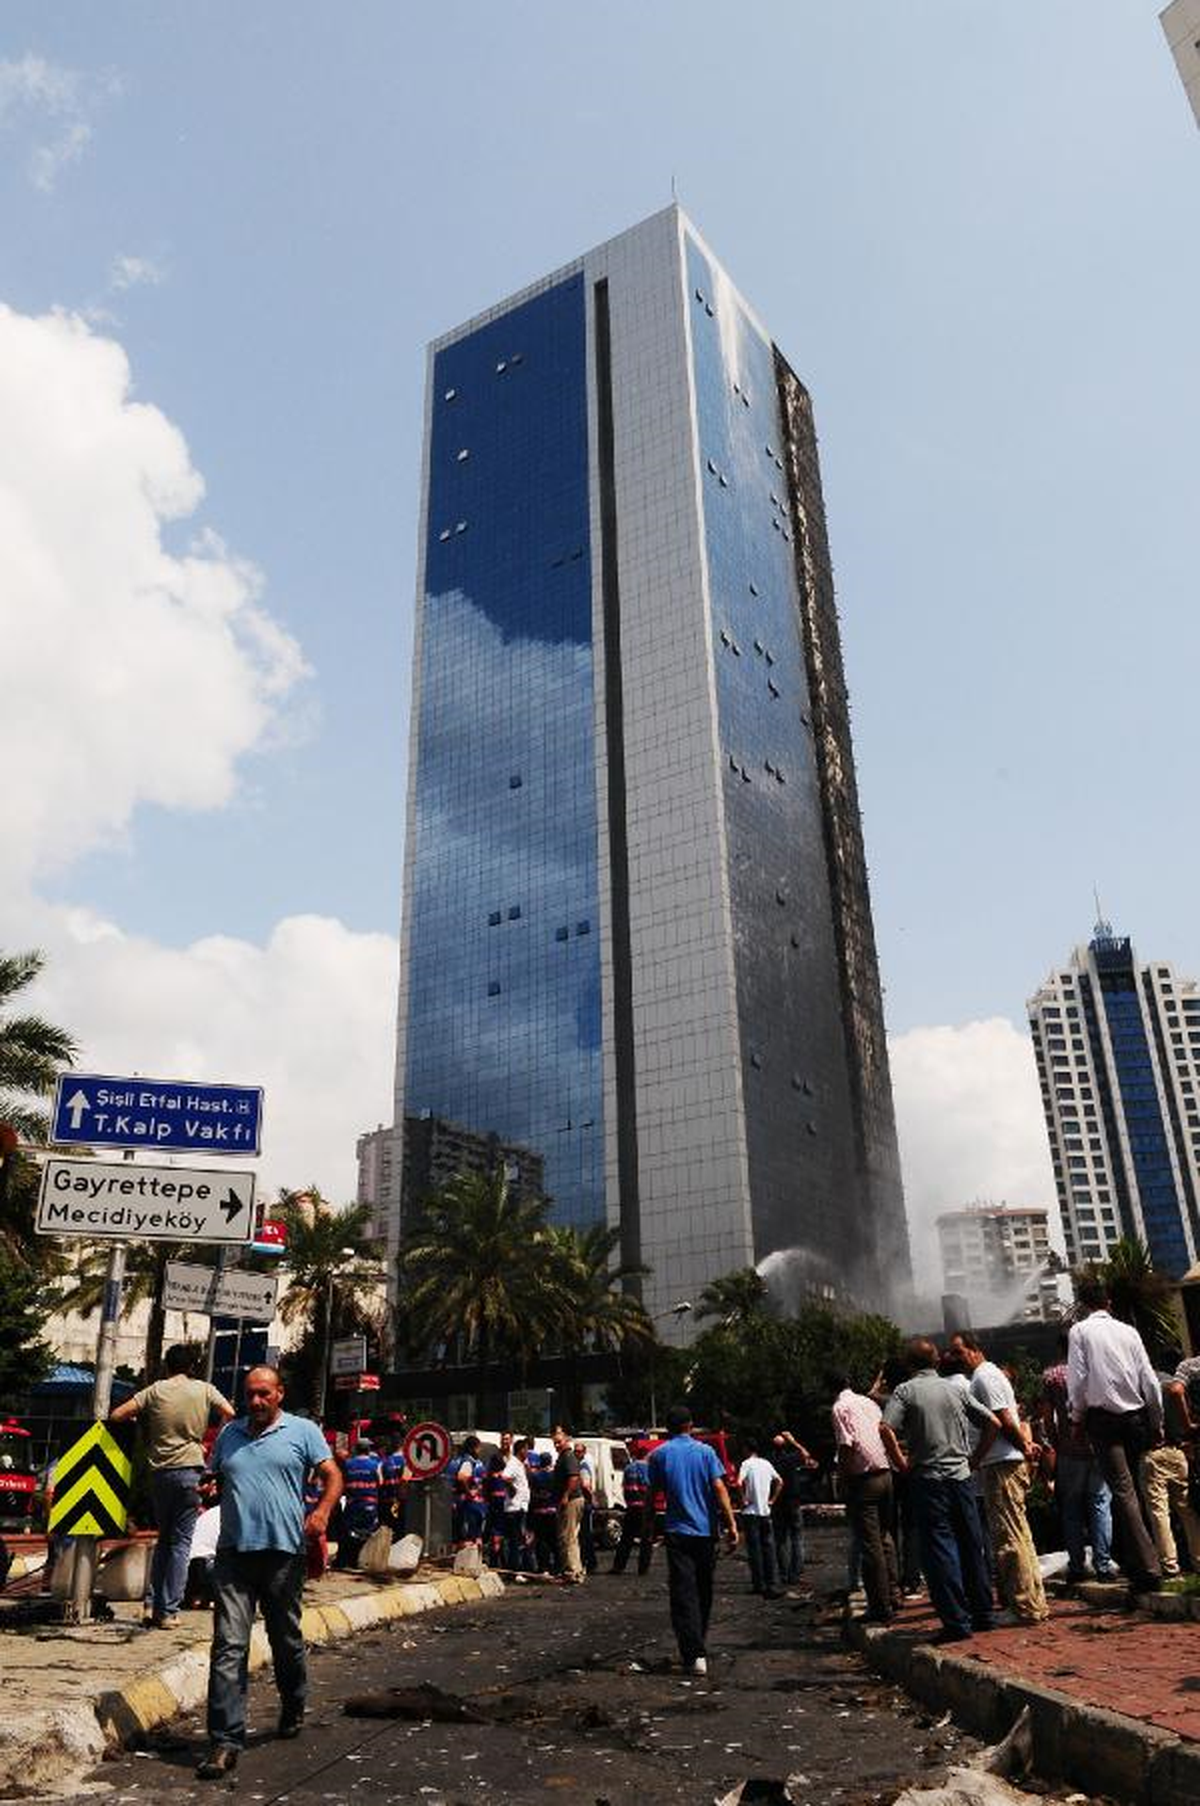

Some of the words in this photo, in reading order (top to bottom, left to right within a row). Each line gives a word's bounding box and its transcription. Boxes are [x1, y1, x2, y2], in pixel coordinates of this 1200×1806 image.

[187, 1096, 233, 1113] Hast.
[94, 1114, 171, 1140] T.Kalp
[54, 1169, 211, 1203] Gayrettepe
[47, 1203, 207, 1234] Mecidiyeköy
